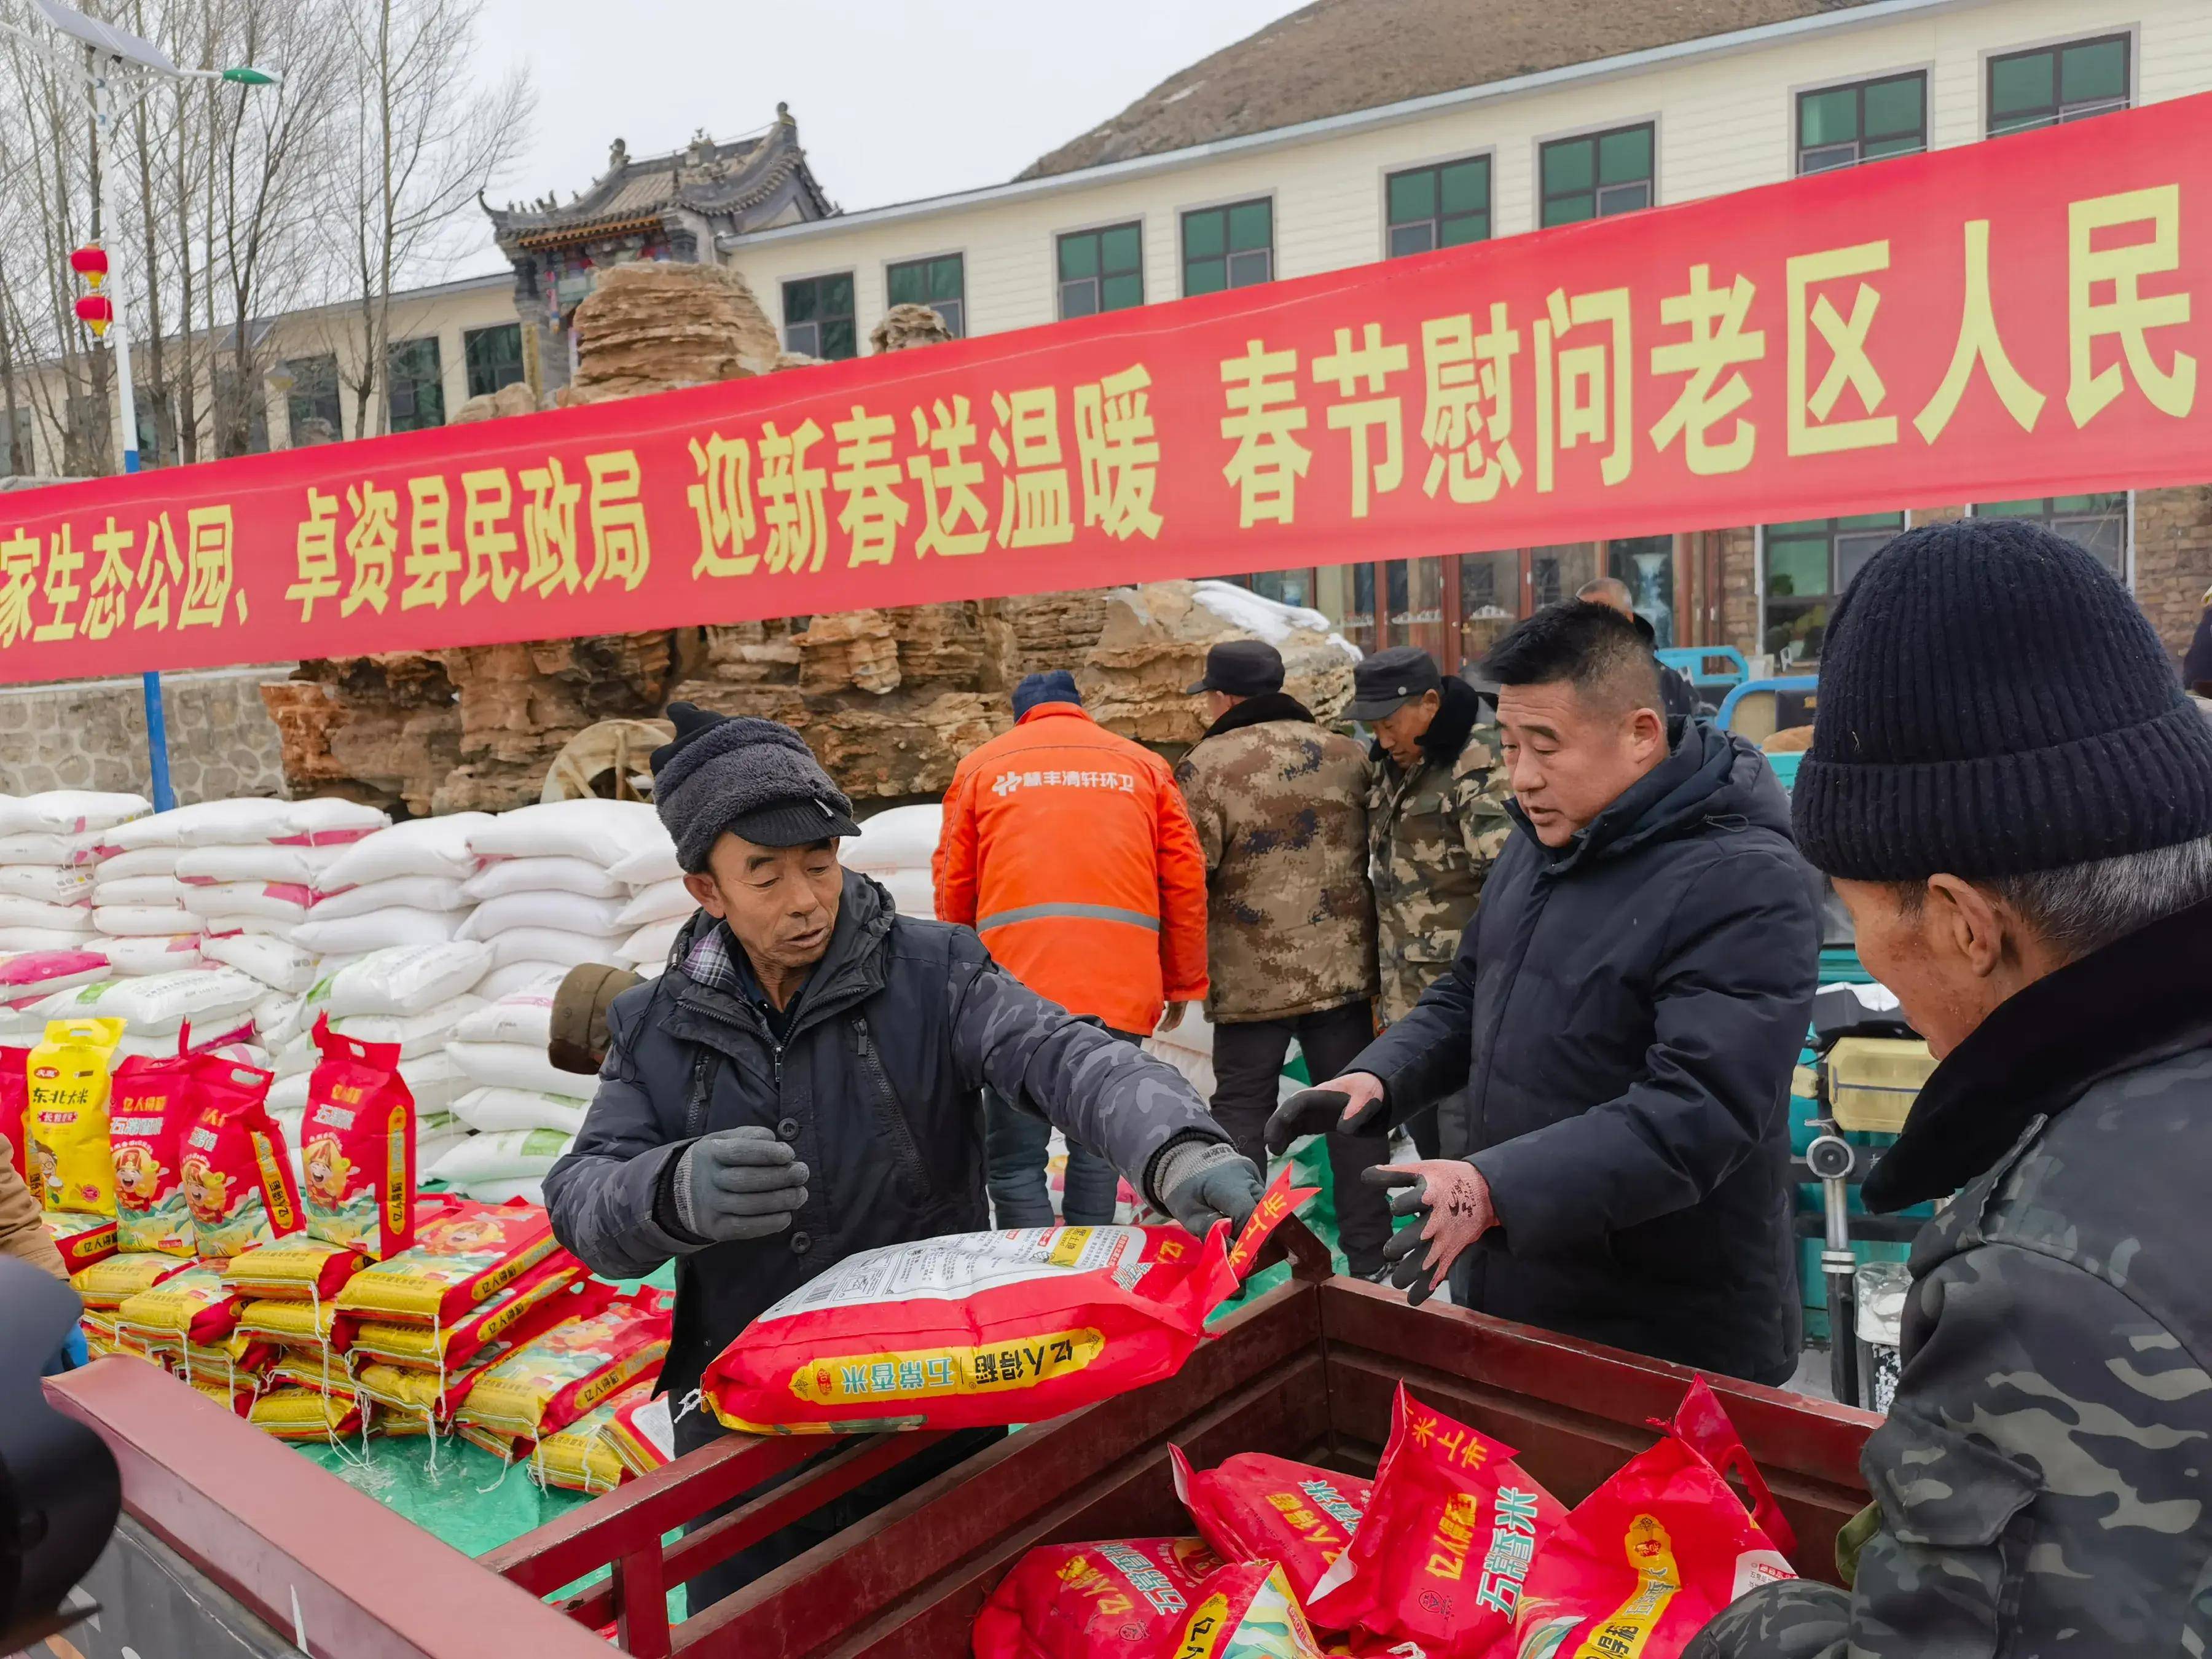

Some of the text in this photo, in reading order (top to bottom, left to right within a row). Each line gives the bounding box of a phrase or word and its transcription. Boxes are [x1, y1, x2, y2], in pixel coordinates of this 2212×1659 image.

[687, 363, 1164, 581] 迎新春送温暖
[1218, 183, 2198, 528] 春节慰问老区人民
[841, 1356, 955, 1395] 五常香米
[975, 1339, 1074, 1385] 亿人得稻
[1405, 1402, 1488, 1470] 米上市
[1093, 1542, 1188, 1616] 五常香米
